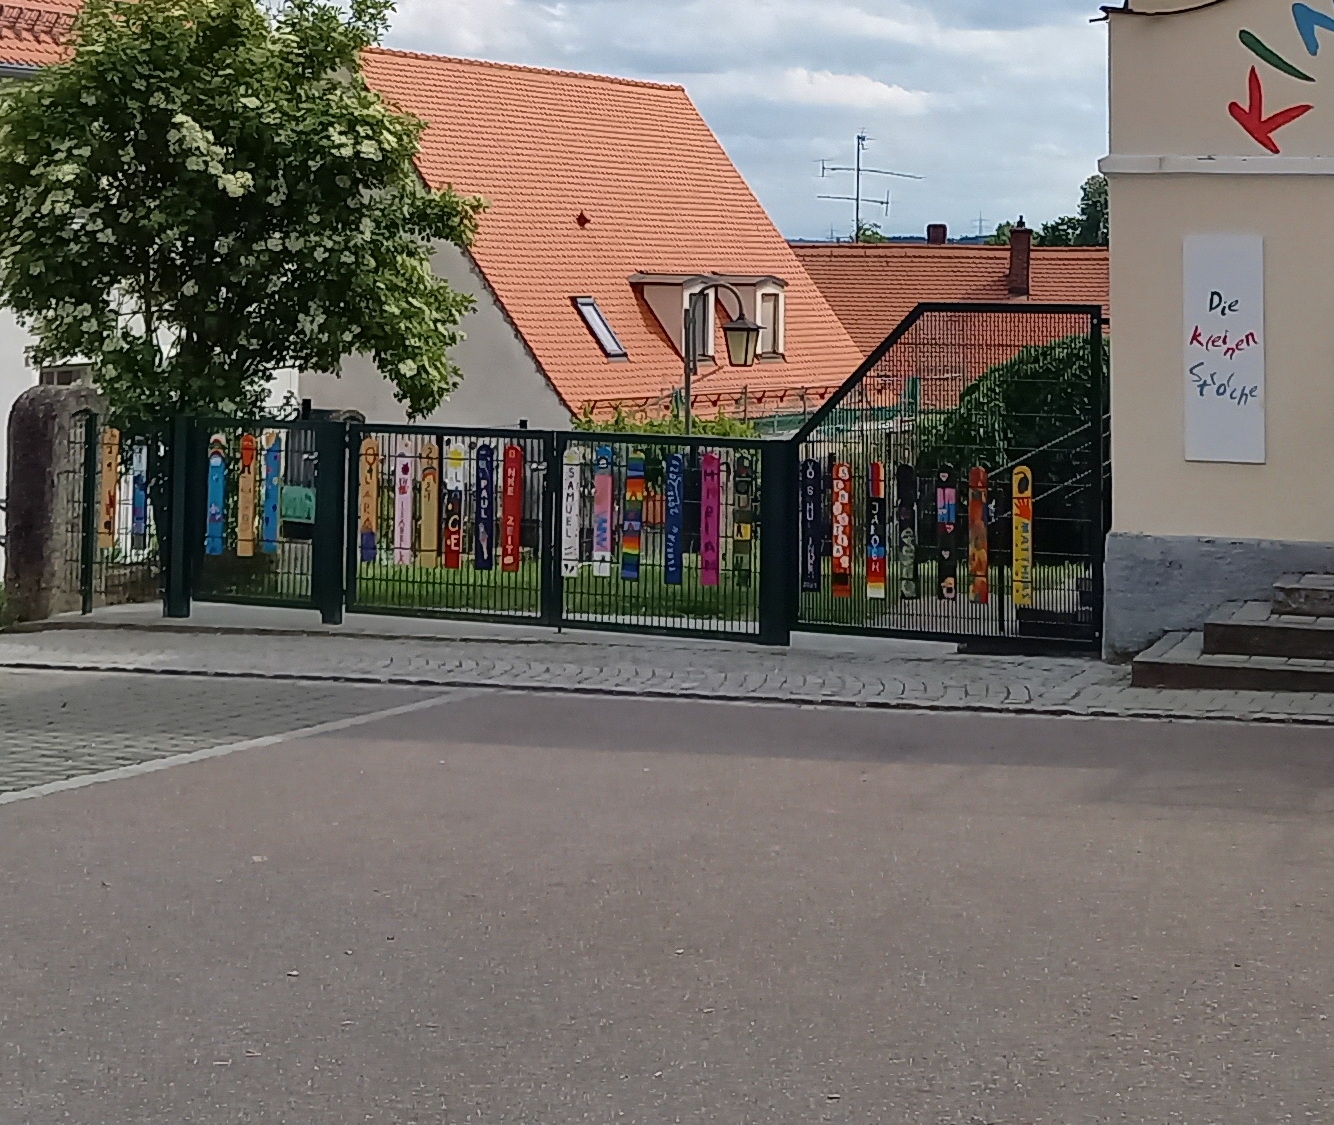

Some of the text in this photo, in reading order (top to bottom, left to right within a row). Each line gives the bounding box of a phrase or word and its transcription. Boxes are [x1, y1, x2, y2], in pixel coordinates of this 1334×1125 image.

[1208, 291, 1240, 316] Die
[480, 480, 489, 519] PAUL
[565, 467, 575, 538] SAMUEL
